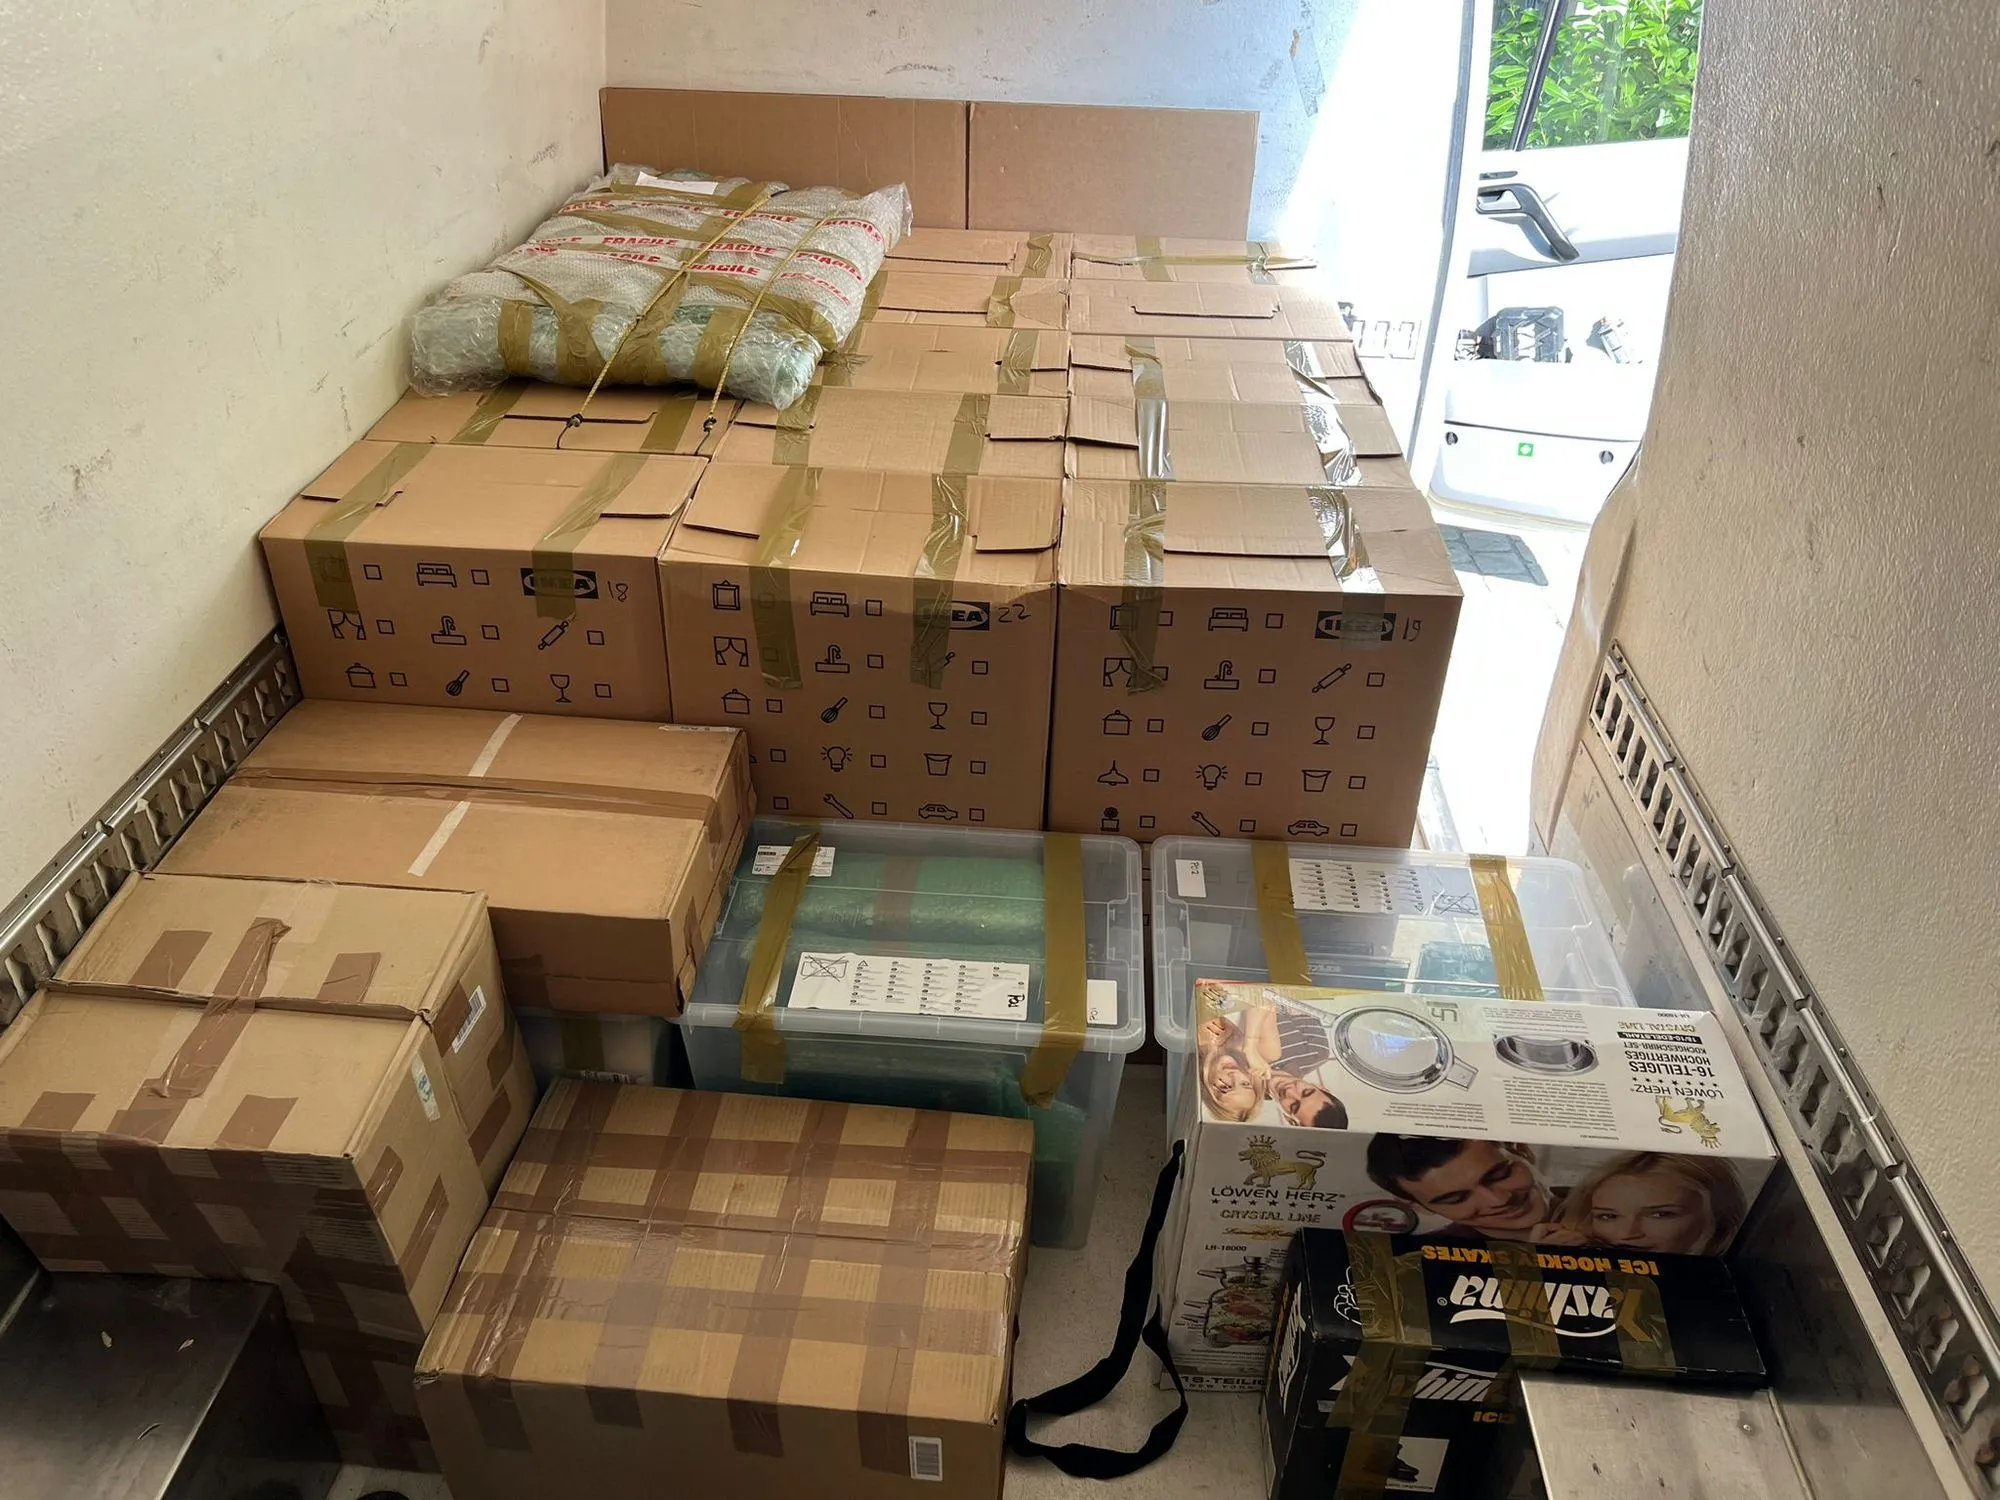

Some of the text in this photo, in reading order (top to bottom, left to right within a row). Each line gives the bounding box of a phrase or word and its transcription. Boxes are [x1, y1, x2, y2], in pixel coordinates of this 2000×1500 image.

[602, 236, 679, 248] FRAGILE
[607, 580, 629, 602] 18
[998, 603, 1031, 623] 22
[1645, 1022, 1696, 1033] CRYSTAL
[1623, 1041, 1707, 1055] KOCHGESCHIRR-SET
[1625, 1051, 1711, 1066] HOCHWERTIGES
[1629, 1061, 1715, 1077] 16-TEILIGES
[1675, 1087, 1724, 1100] LÖWEN
[1211, 1185, 1279, 1199] LÖWEN
[1220, 1209, 1322, 1223] CRYSTAL LINE
[1619, 1259, 1660, 1276] ICE
